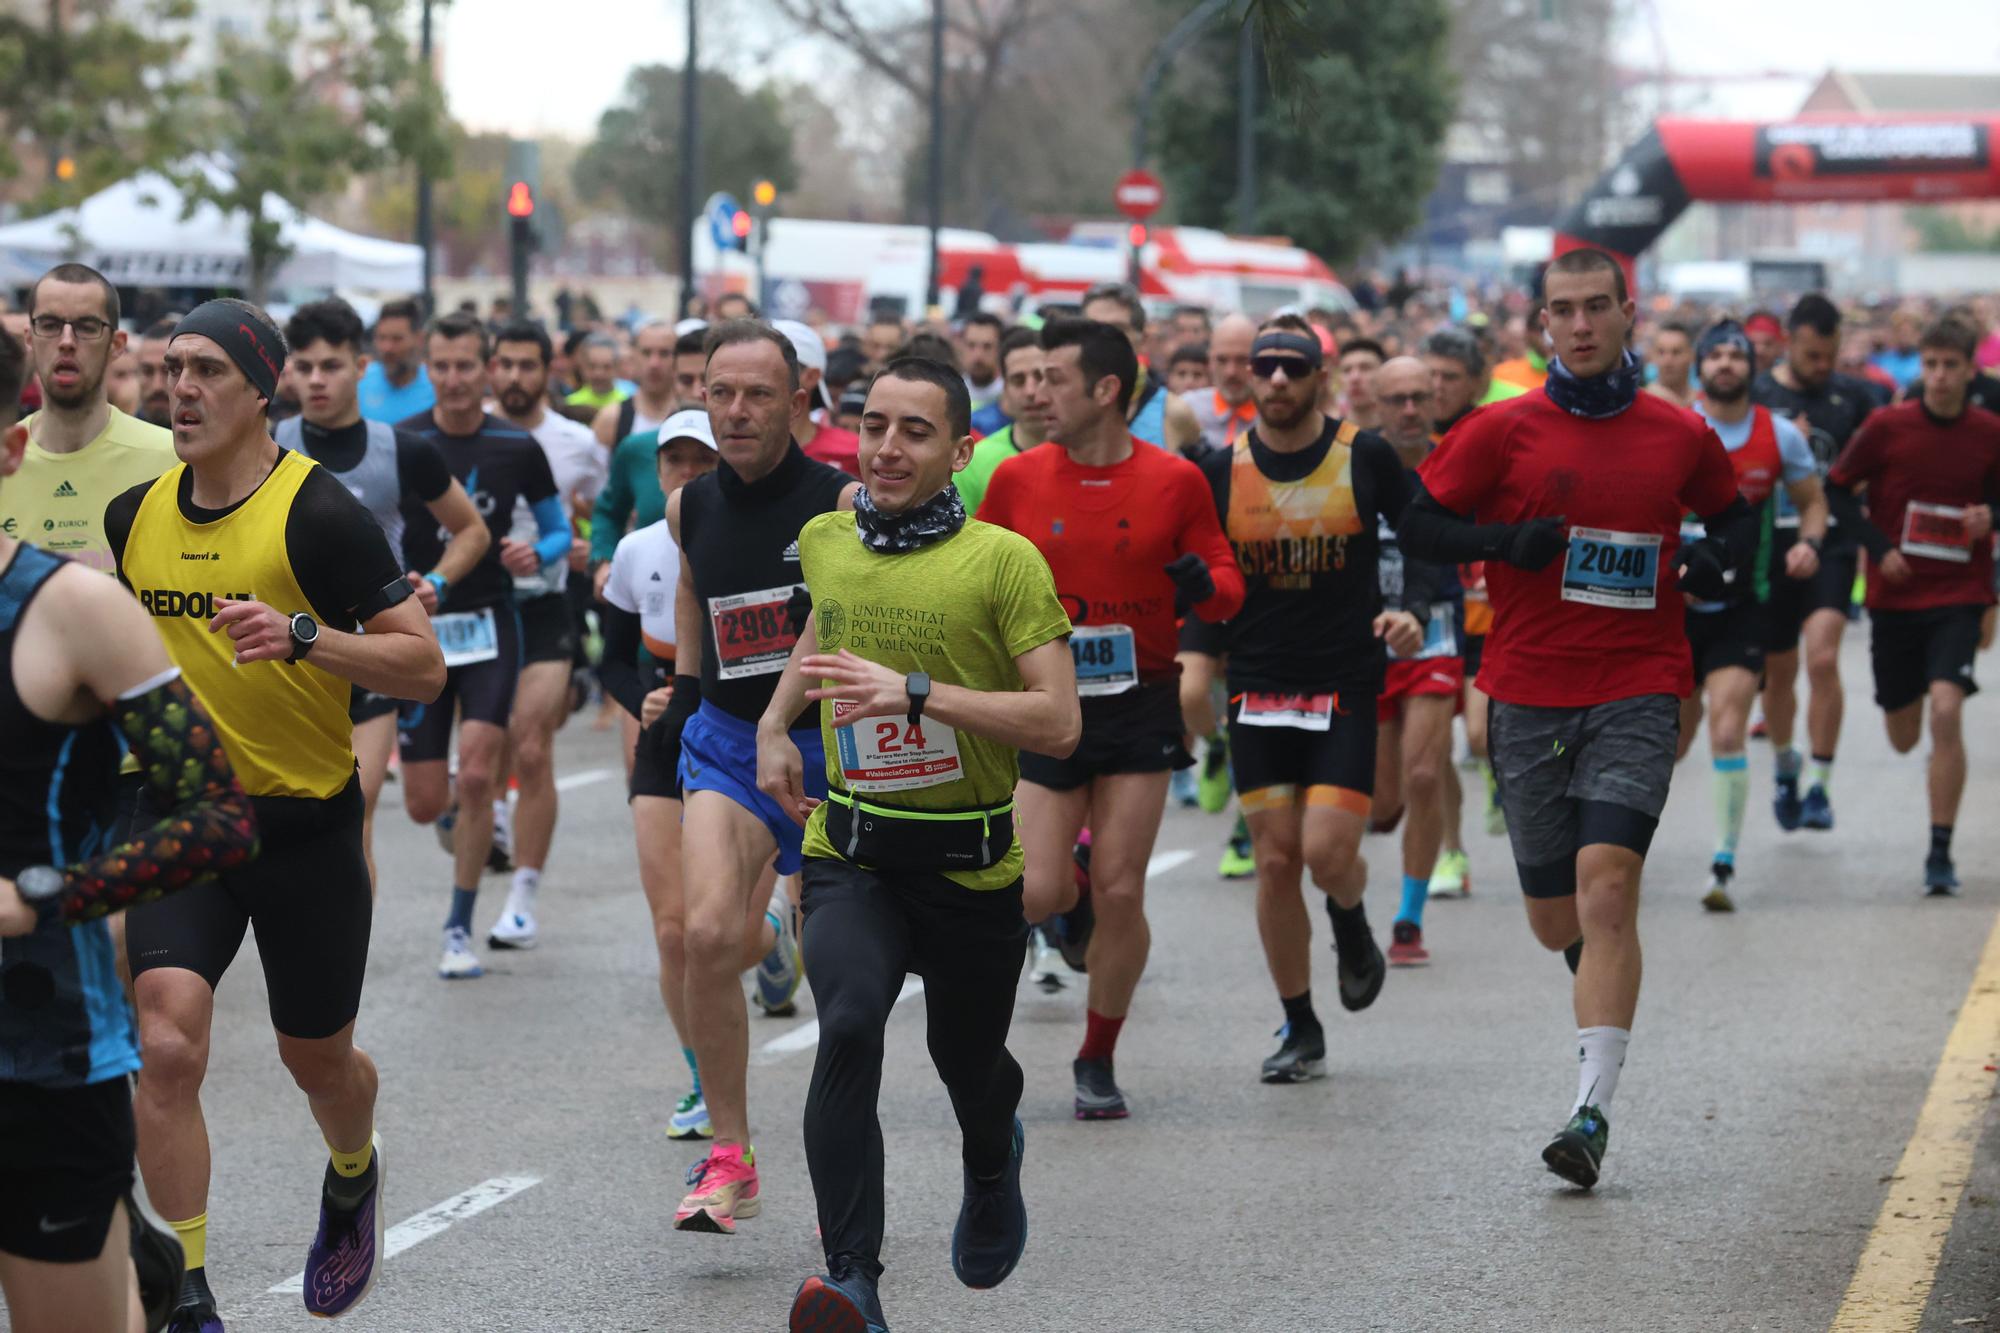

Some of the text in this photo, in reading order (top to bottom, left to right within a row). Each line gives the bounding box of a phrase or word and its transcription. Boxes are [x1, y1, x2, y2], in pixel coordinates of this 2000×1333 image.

[58, 519, 88, 528] ZURICH
[180, 551, 209, 561] luanvi
[1578, 542, 1647, 577] 2040
[853, 604, 948, 626] UNIVERSITAT
[851, 620, 945, 641] POLITÈCNICA
[850, 636, 945, 656] DE VALÈNCIA
[876, 722, 927, 753] 24
